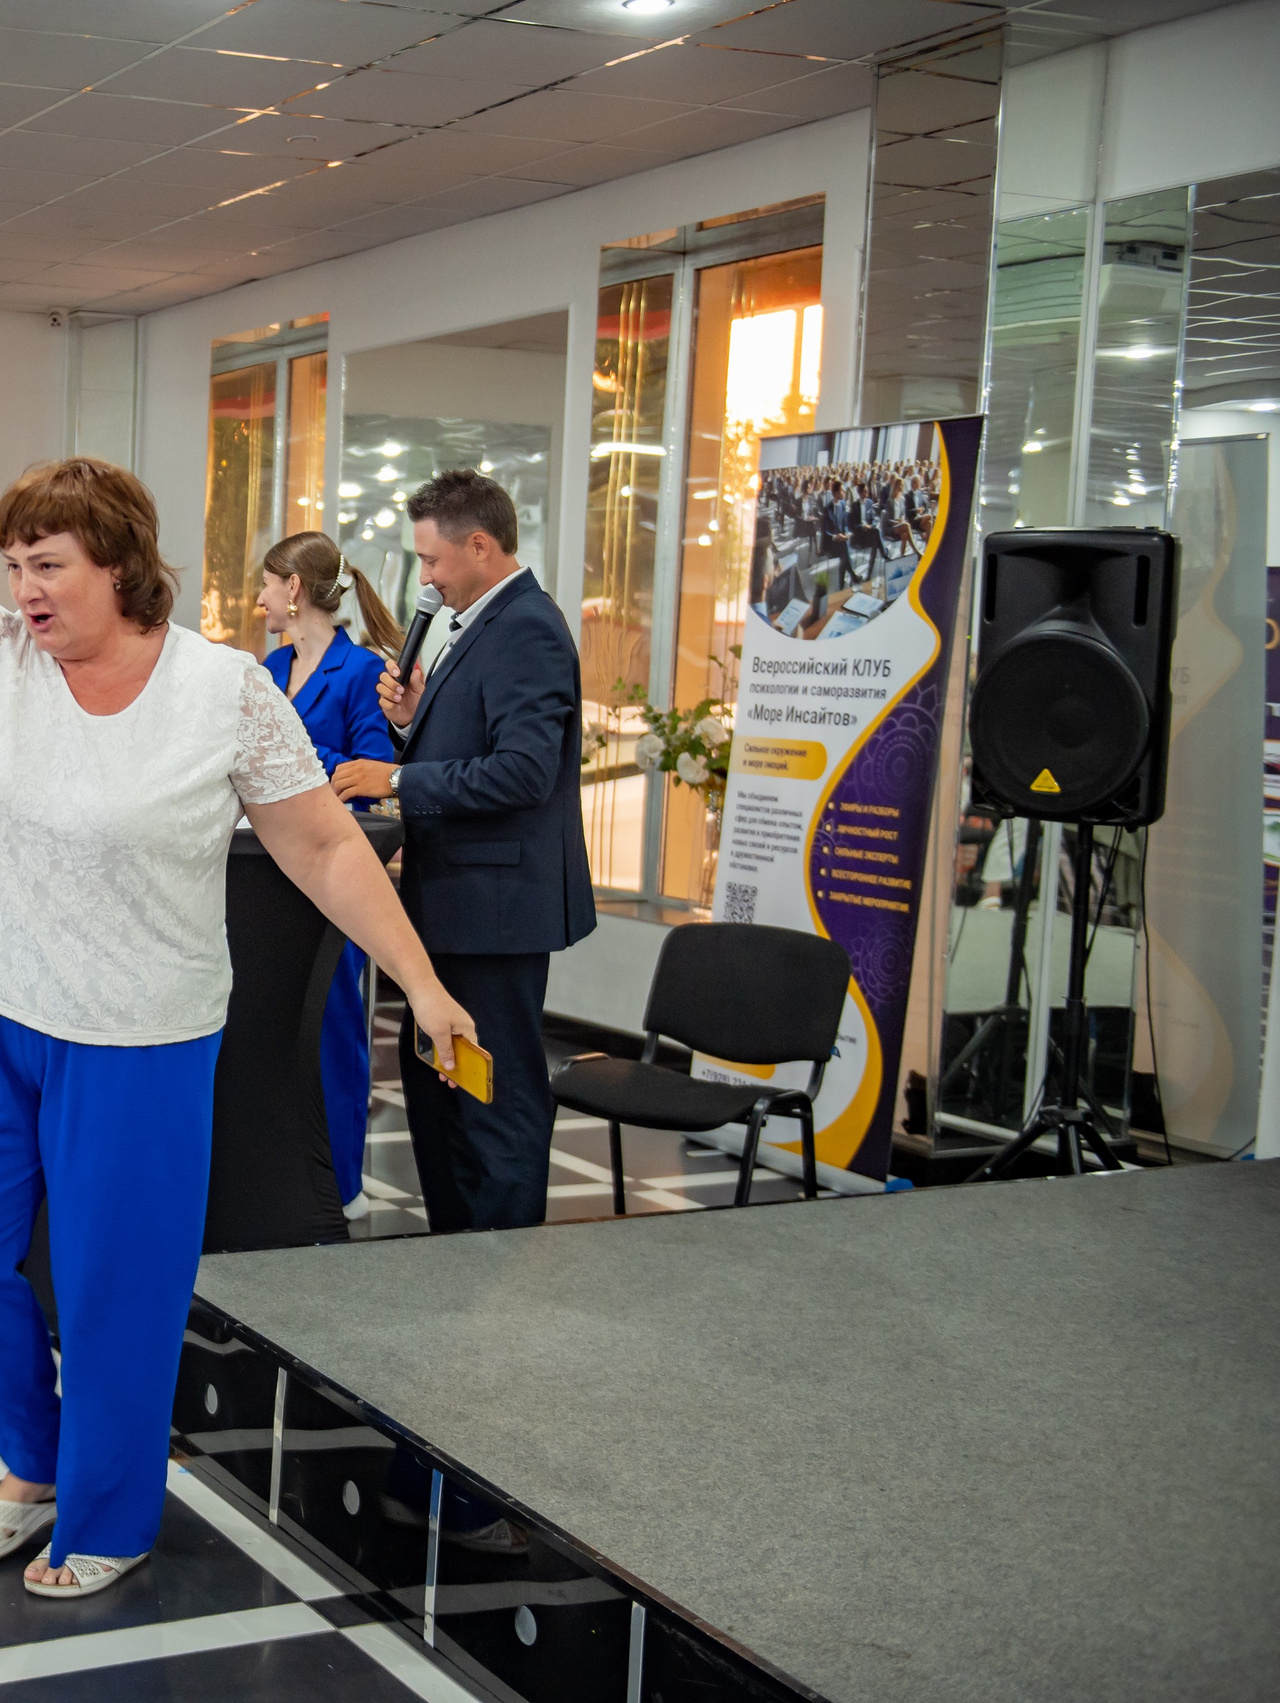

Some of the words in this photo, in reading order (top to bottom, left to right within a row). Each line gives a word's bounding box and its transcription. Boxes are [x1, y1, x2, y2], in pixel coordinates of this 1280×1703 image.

[752, 656, 848, 677] Всероссийский
[851, 658, 891, 678] КЛУБ
[749, 682, 799, 696] психологии
[801, 685, 808, 695] и
[810, 685, 887, 699] саморазвития
[747, 703, 783, 726] «Море
[785, 704, 858, 726] Инсайтов»
